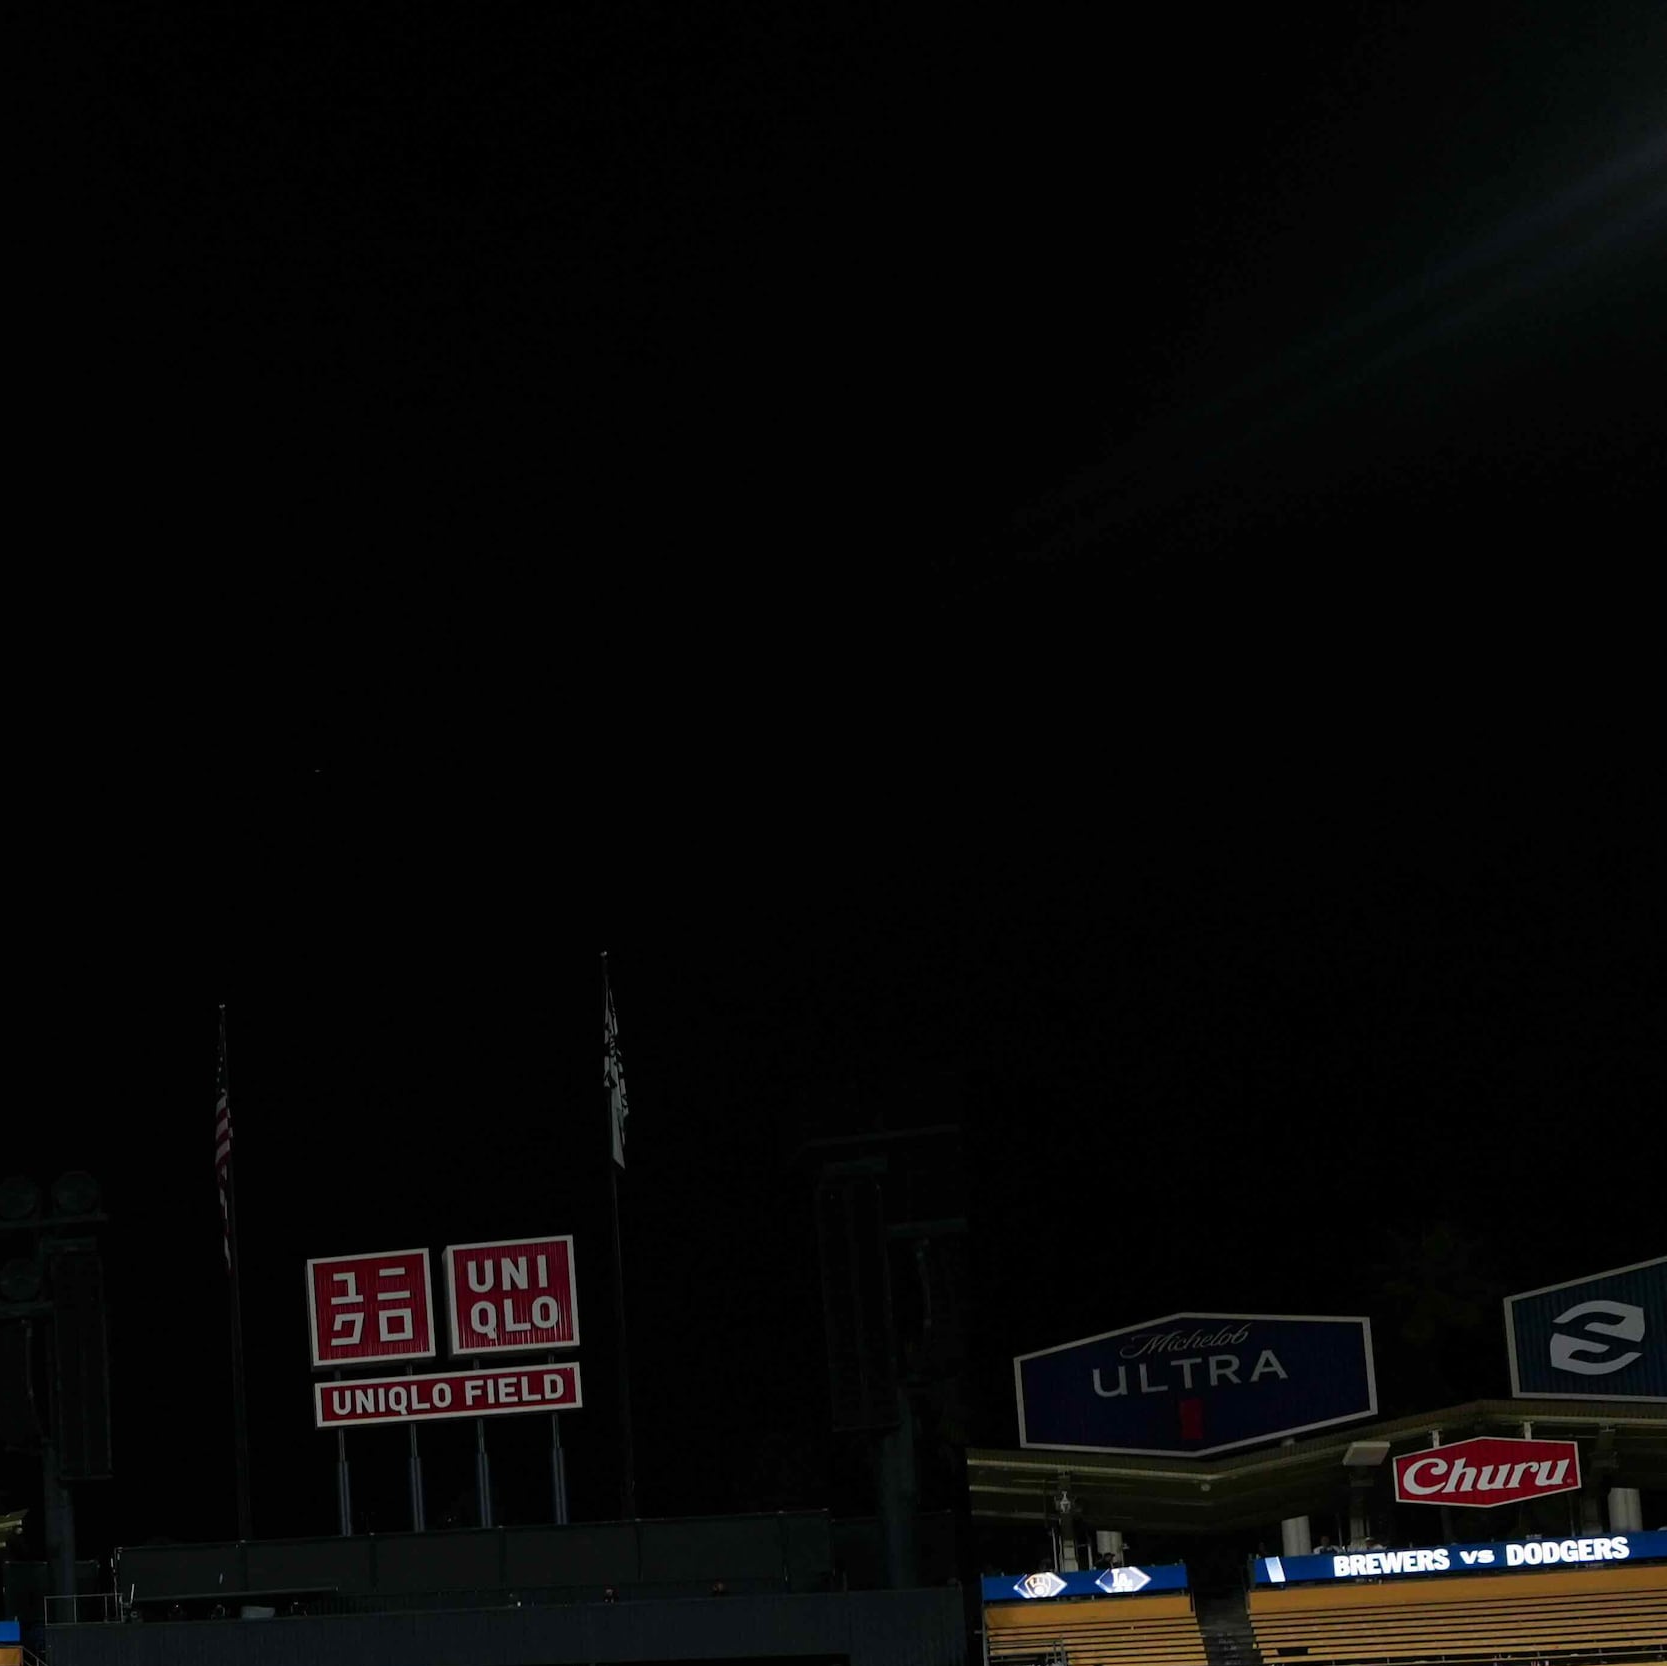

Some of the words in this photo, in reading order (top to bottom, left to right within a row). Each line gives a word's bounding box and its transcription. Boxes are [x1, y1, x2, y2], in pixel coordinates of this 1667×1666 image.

[468, 1253, 549, 1294] UNI
[470, 1296, 561, 1340] QLO
[1120, 1322, 1249, 1360] Michelob
[332, 1381, 453, 1416] UNIQLO
[464, 1374, 565, 1407] FIELD
[1092, 1349, 1288, 1399] ULTRA
[1402, 1454, 1569, 1496] Churu
[1333, 1548, 1450, 1576] BREWERS
[1505, 1536, 1630, 1567] DODGERS
